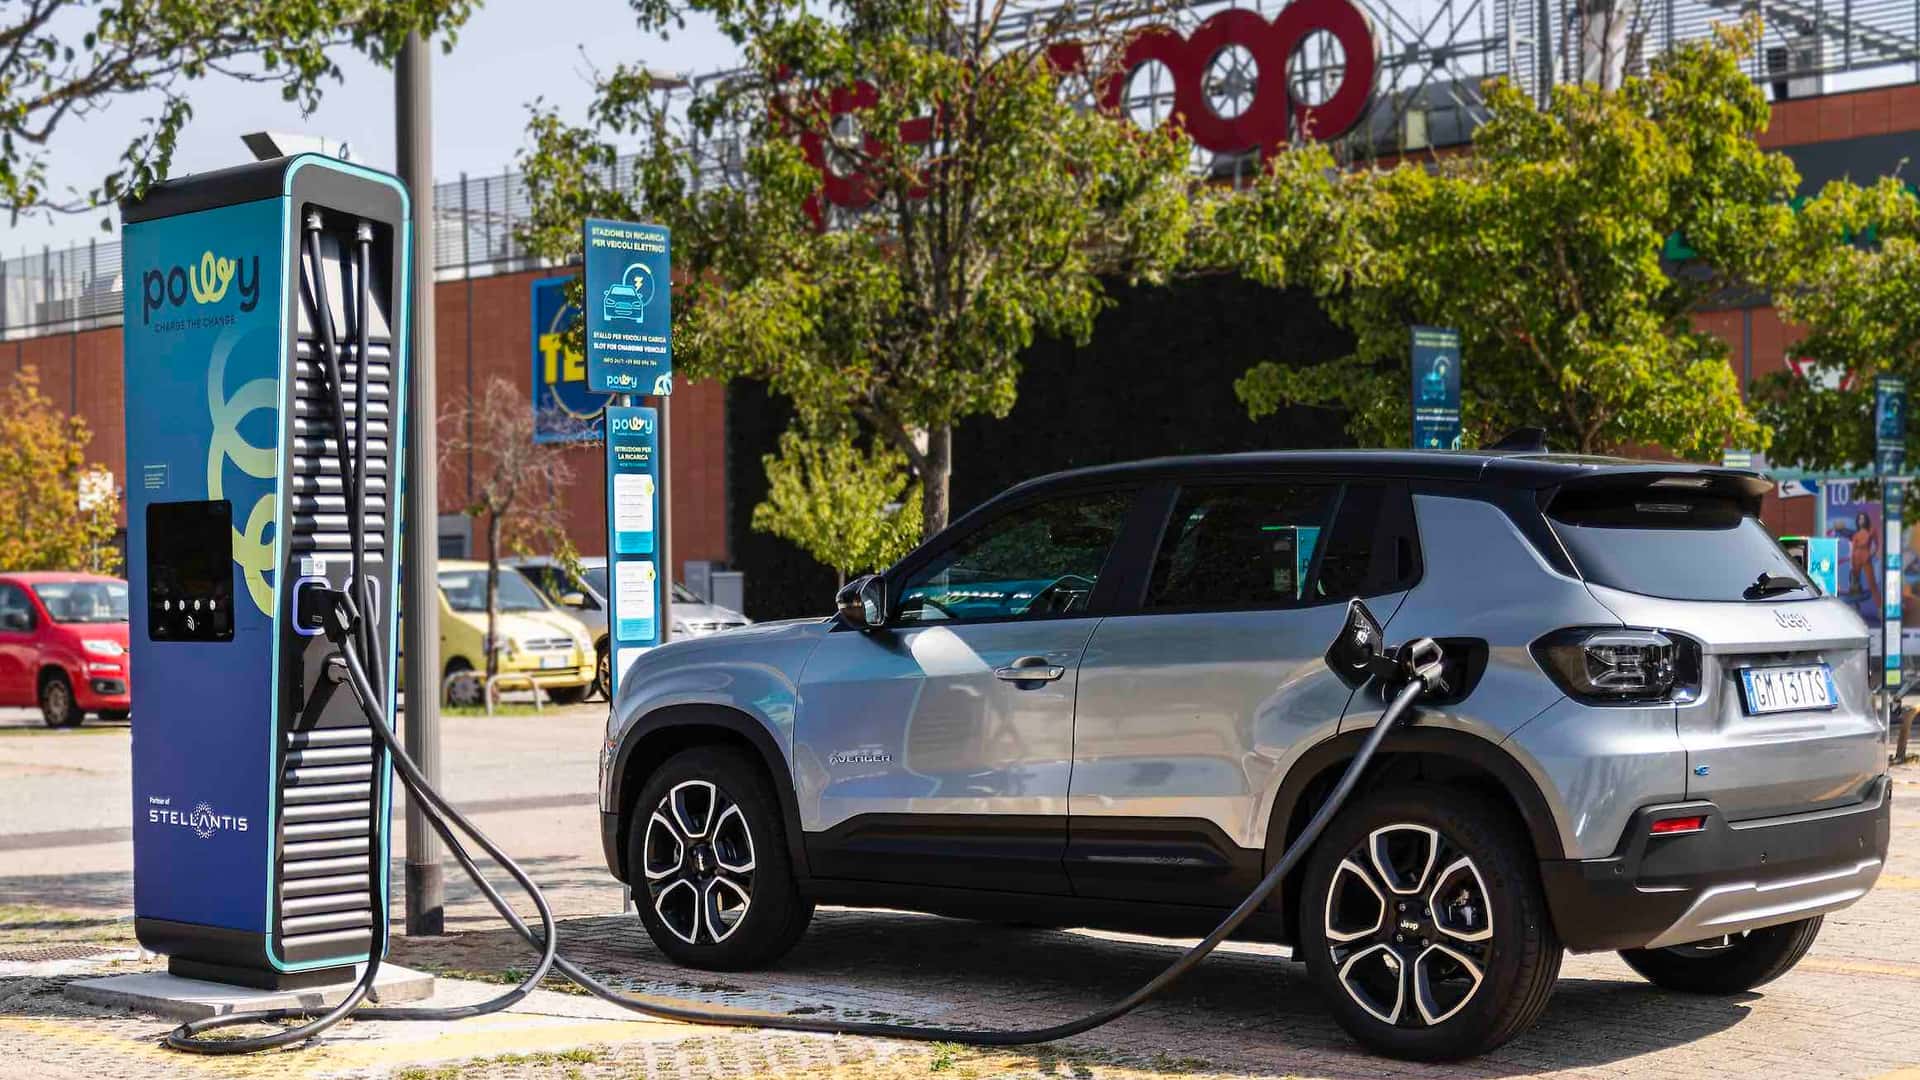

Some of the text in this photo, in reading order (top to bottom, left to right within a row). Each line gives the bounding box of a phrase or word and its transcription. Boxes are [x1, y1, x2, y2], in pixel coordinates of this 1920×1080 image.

[592, 227, 665, 242] STAZIONE DI RICARICA
[592, 239, 665, 253] PER VEICOLI ELETTRICI
[186, 318, 202, 328] THE
[203, 314, 236, 328] CHANGE
[593, 331, 612, 340] STALLO
[149, 810, 248, 831] STELLANTIS
